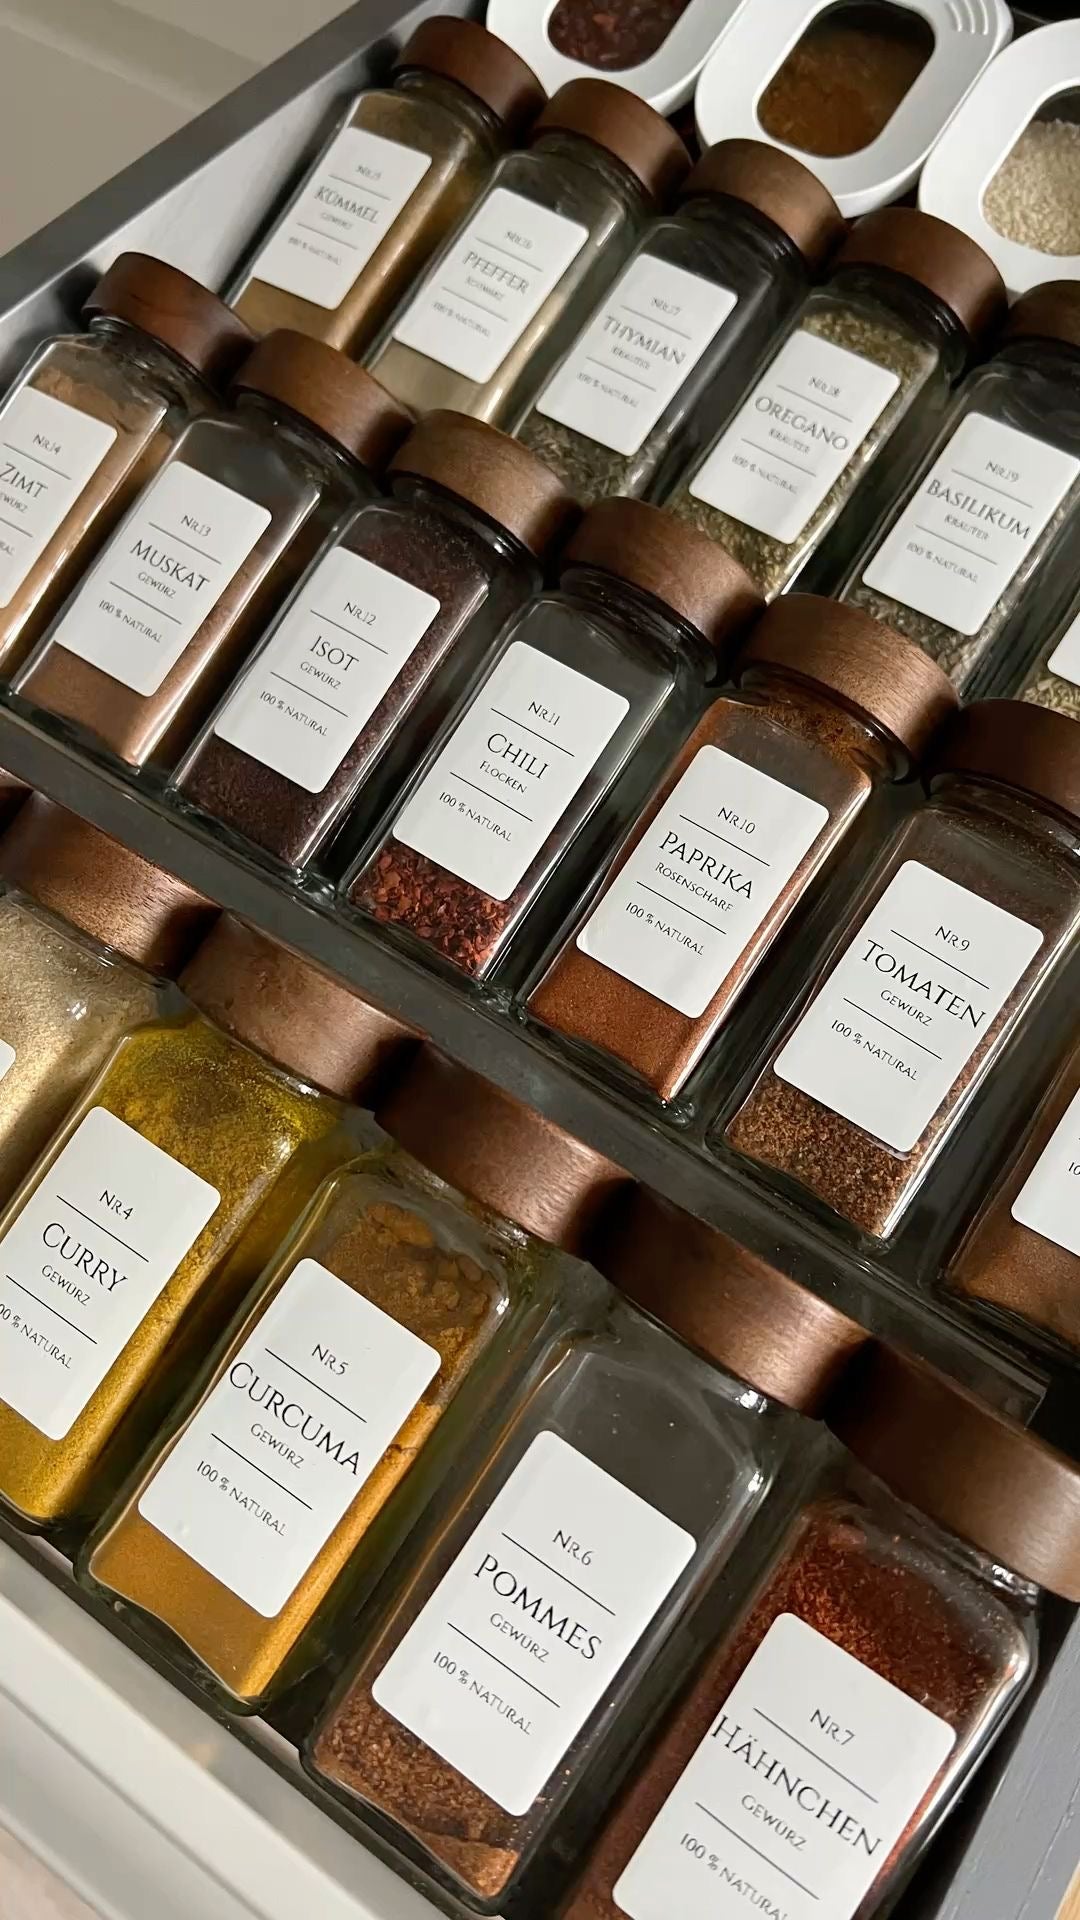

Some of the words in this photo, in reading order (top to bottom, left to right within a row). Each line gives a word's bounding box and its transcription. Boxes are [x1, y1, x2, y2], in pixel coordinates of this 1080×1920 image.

[462, 251, 529, 294] PFEFFER
[603, 316, 686, 364] THYMIAN
[755, 396, 849, 451] OREGANO
[0, 463, 48, 498] ZIMT
[926, 479, 1032, 540] BASILIKUM
[130, 539, 211, 593] MUSKAT
[309, 636, 359, 671] ISOT
[260, 691, 277, 707] 100
[277, 701, 285, 711] %
[285, 706, 327, 737] NATURAL
[480, 760, 527, 793] FLOCKEN
[487, 733, 549, 779] CHILI
[440, 791, 457, 807] 100
[458, 803, 466, 813] %
[466, 808, 512, 842] NATURAL
[717, 806, 756, 834] NR.10
[655, 862, 733, 912] ROSENSCHARF
[659, 831, 753, 899] PAPRIKA
[626, 901, 645, 919] 100
[645, 913, 654, 924] %
[654, 920, 705, 955] NATURAL
[935, 925, 970, 952] NR.9
[861, 939, 986, 1028] TOMATEN
[831, 1019, 852, 1038] 100
[853, 1031, 863, 1045] %
[863, 1039, 918, 1081] NATURAL
[1069, 1162, 1080, 1175] 10
[99, 1189, 134, 1219] NR.4
[42, 1221, 128, 1294] CURRY
[11, 1315, 20, 1328] %
[20, 1324, 74, 1369] NATURAL
[312, 1344, 349, 1375] NR.5
[229, 1362, 361, 1475] CURCUMA
[197, 1460, 218, 1483] 100
[219, 1477, 228, 1491] %
[229, 1487, 289, 1536] NATURAL
[552, 1529, 595, 1566] NR.6
[474, 1553, 602, 1660] POMMES
[433, 1651, 457, 1675] 100
[458, 1670, 469, 1685] %
[469, 1680, 533, 1735] NATURAL
[809, 1709, 855, 1746] NR.7
[712, 1714, 883, 1856] HÄHNCHEN
[680, 1832, 705, 1859] 100
[707, 1854, 719, 1870] %
